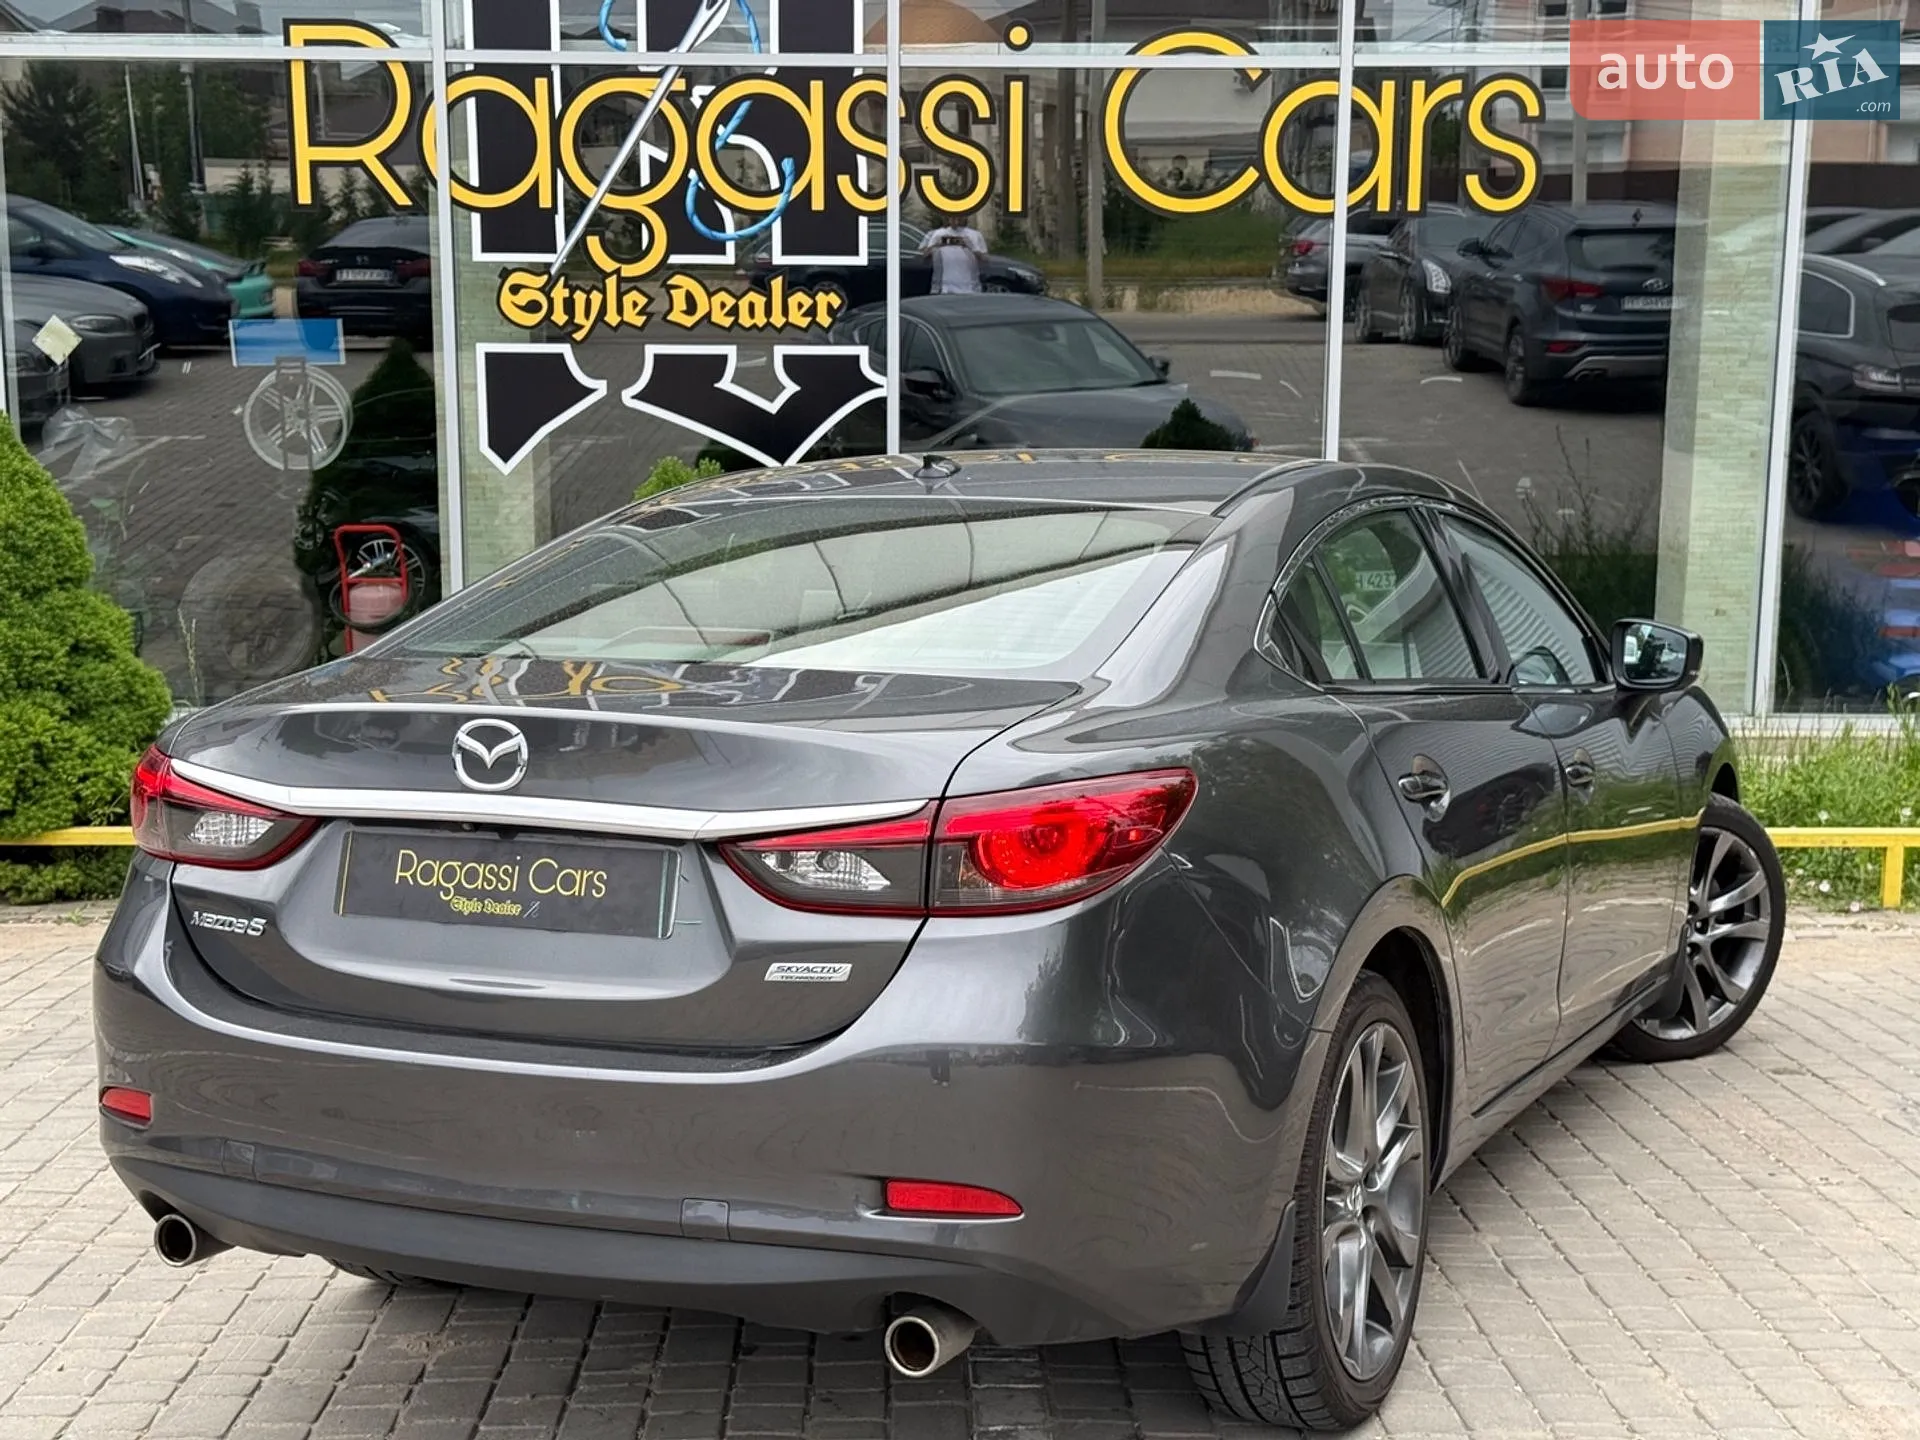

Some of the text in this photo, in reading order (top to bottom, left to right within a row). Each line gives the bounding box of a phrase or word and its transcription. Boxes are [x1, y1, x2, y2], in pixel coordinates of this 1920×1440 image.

[284, 20, 1543, 278] Ragassi Cars
[499, 270, 844, 342] Style Dealer
[394, 849, 608, 901] Ragassi Cars
[450, 895, 522, 916] Style Dealer
[775, 965, 844, 974] SKYACTIV
